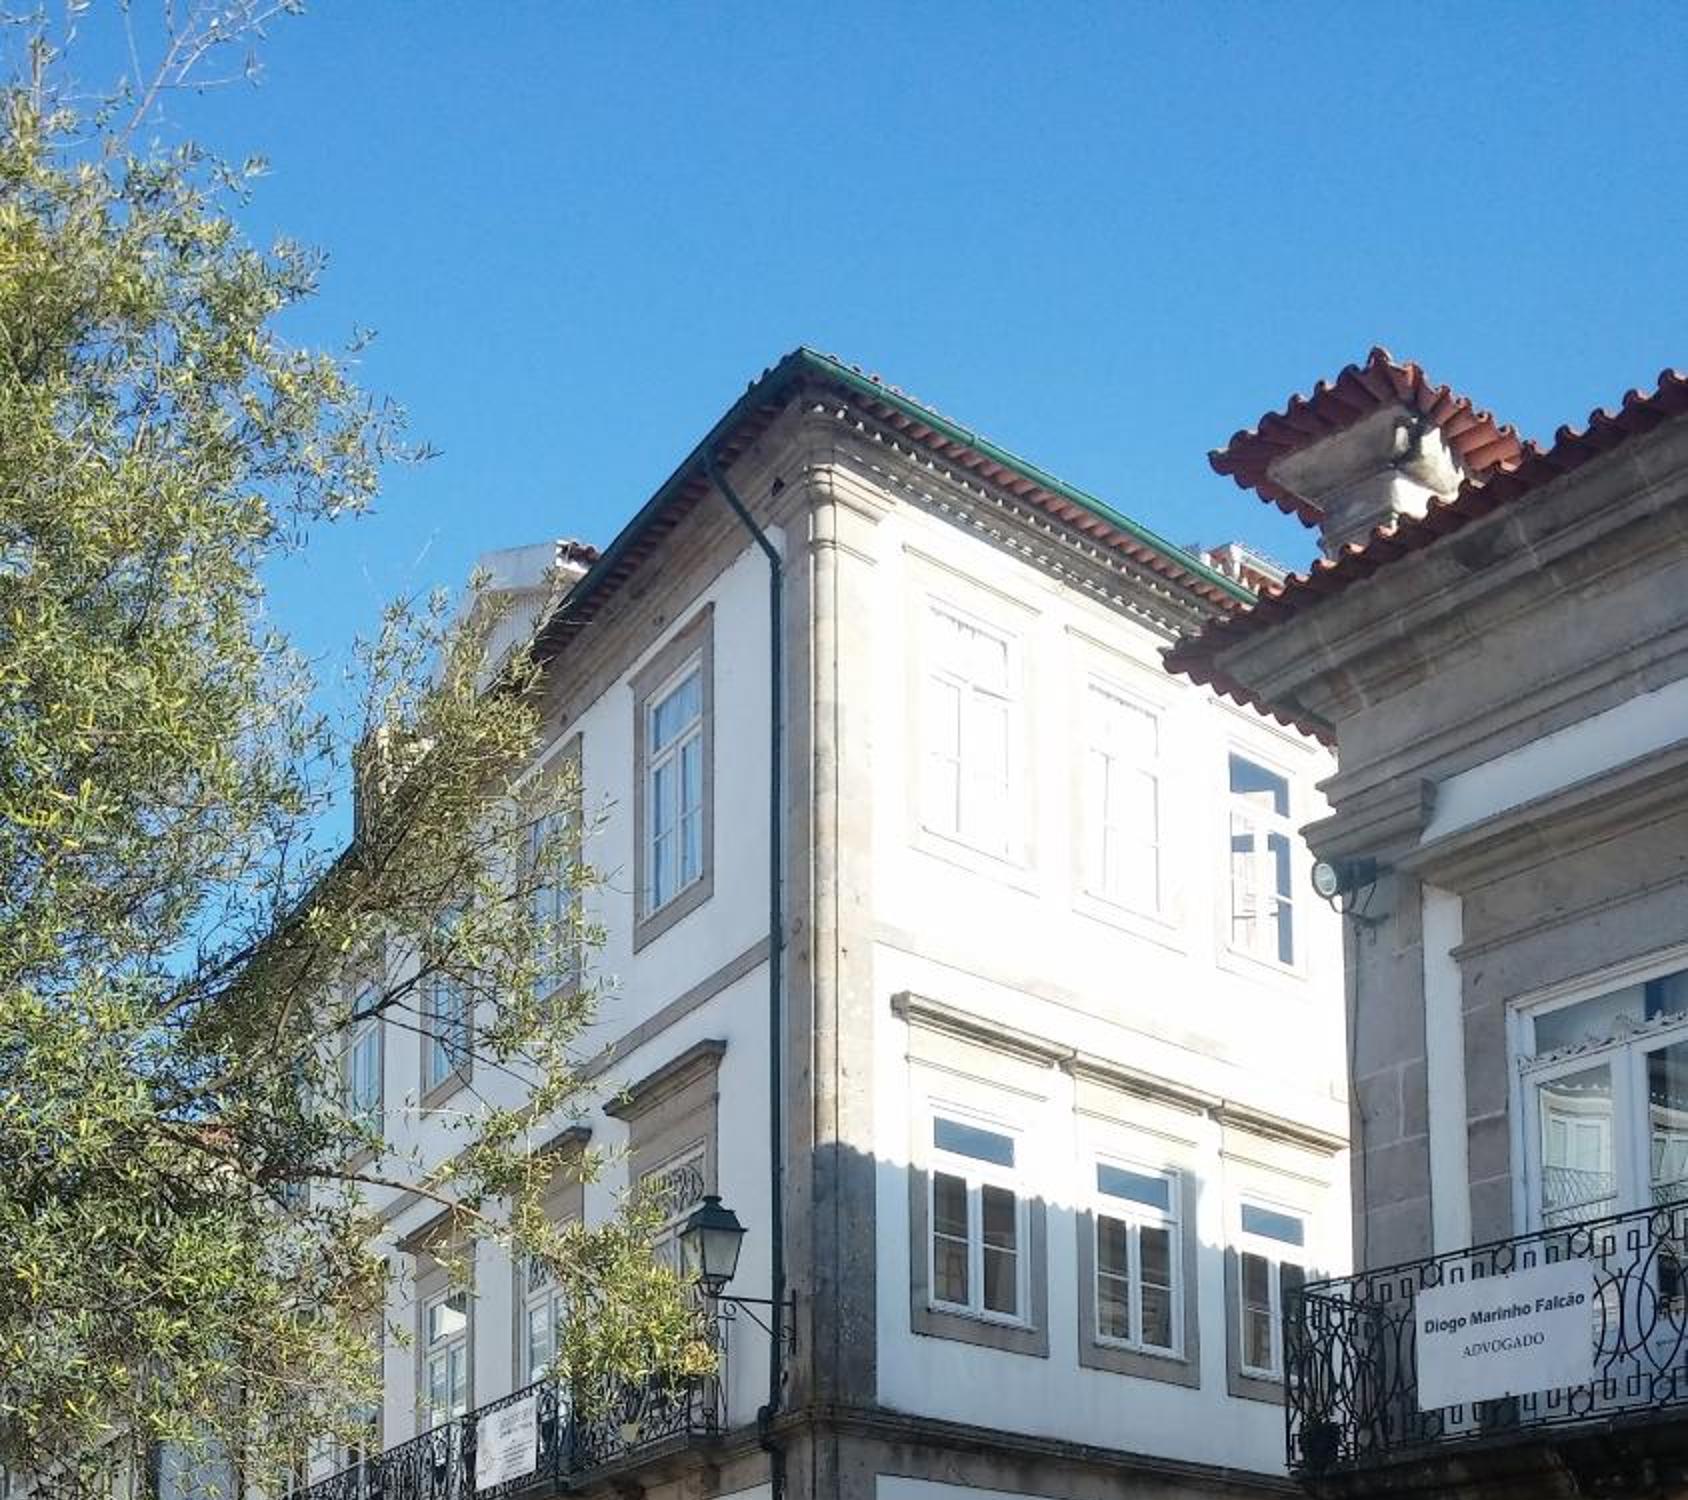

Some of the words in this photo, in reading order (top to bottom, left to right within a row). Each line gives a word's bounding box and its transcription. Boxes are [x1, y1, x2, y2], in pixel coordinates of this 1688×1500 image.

[1425, 1315, 1467, 1334] Diogo
[1470, 1303, 1531, 1325] Marinho
[1535, 1291, 1585, 1313] Falcão
[1462, 1331, 1545, 1358] ADVOGADO
